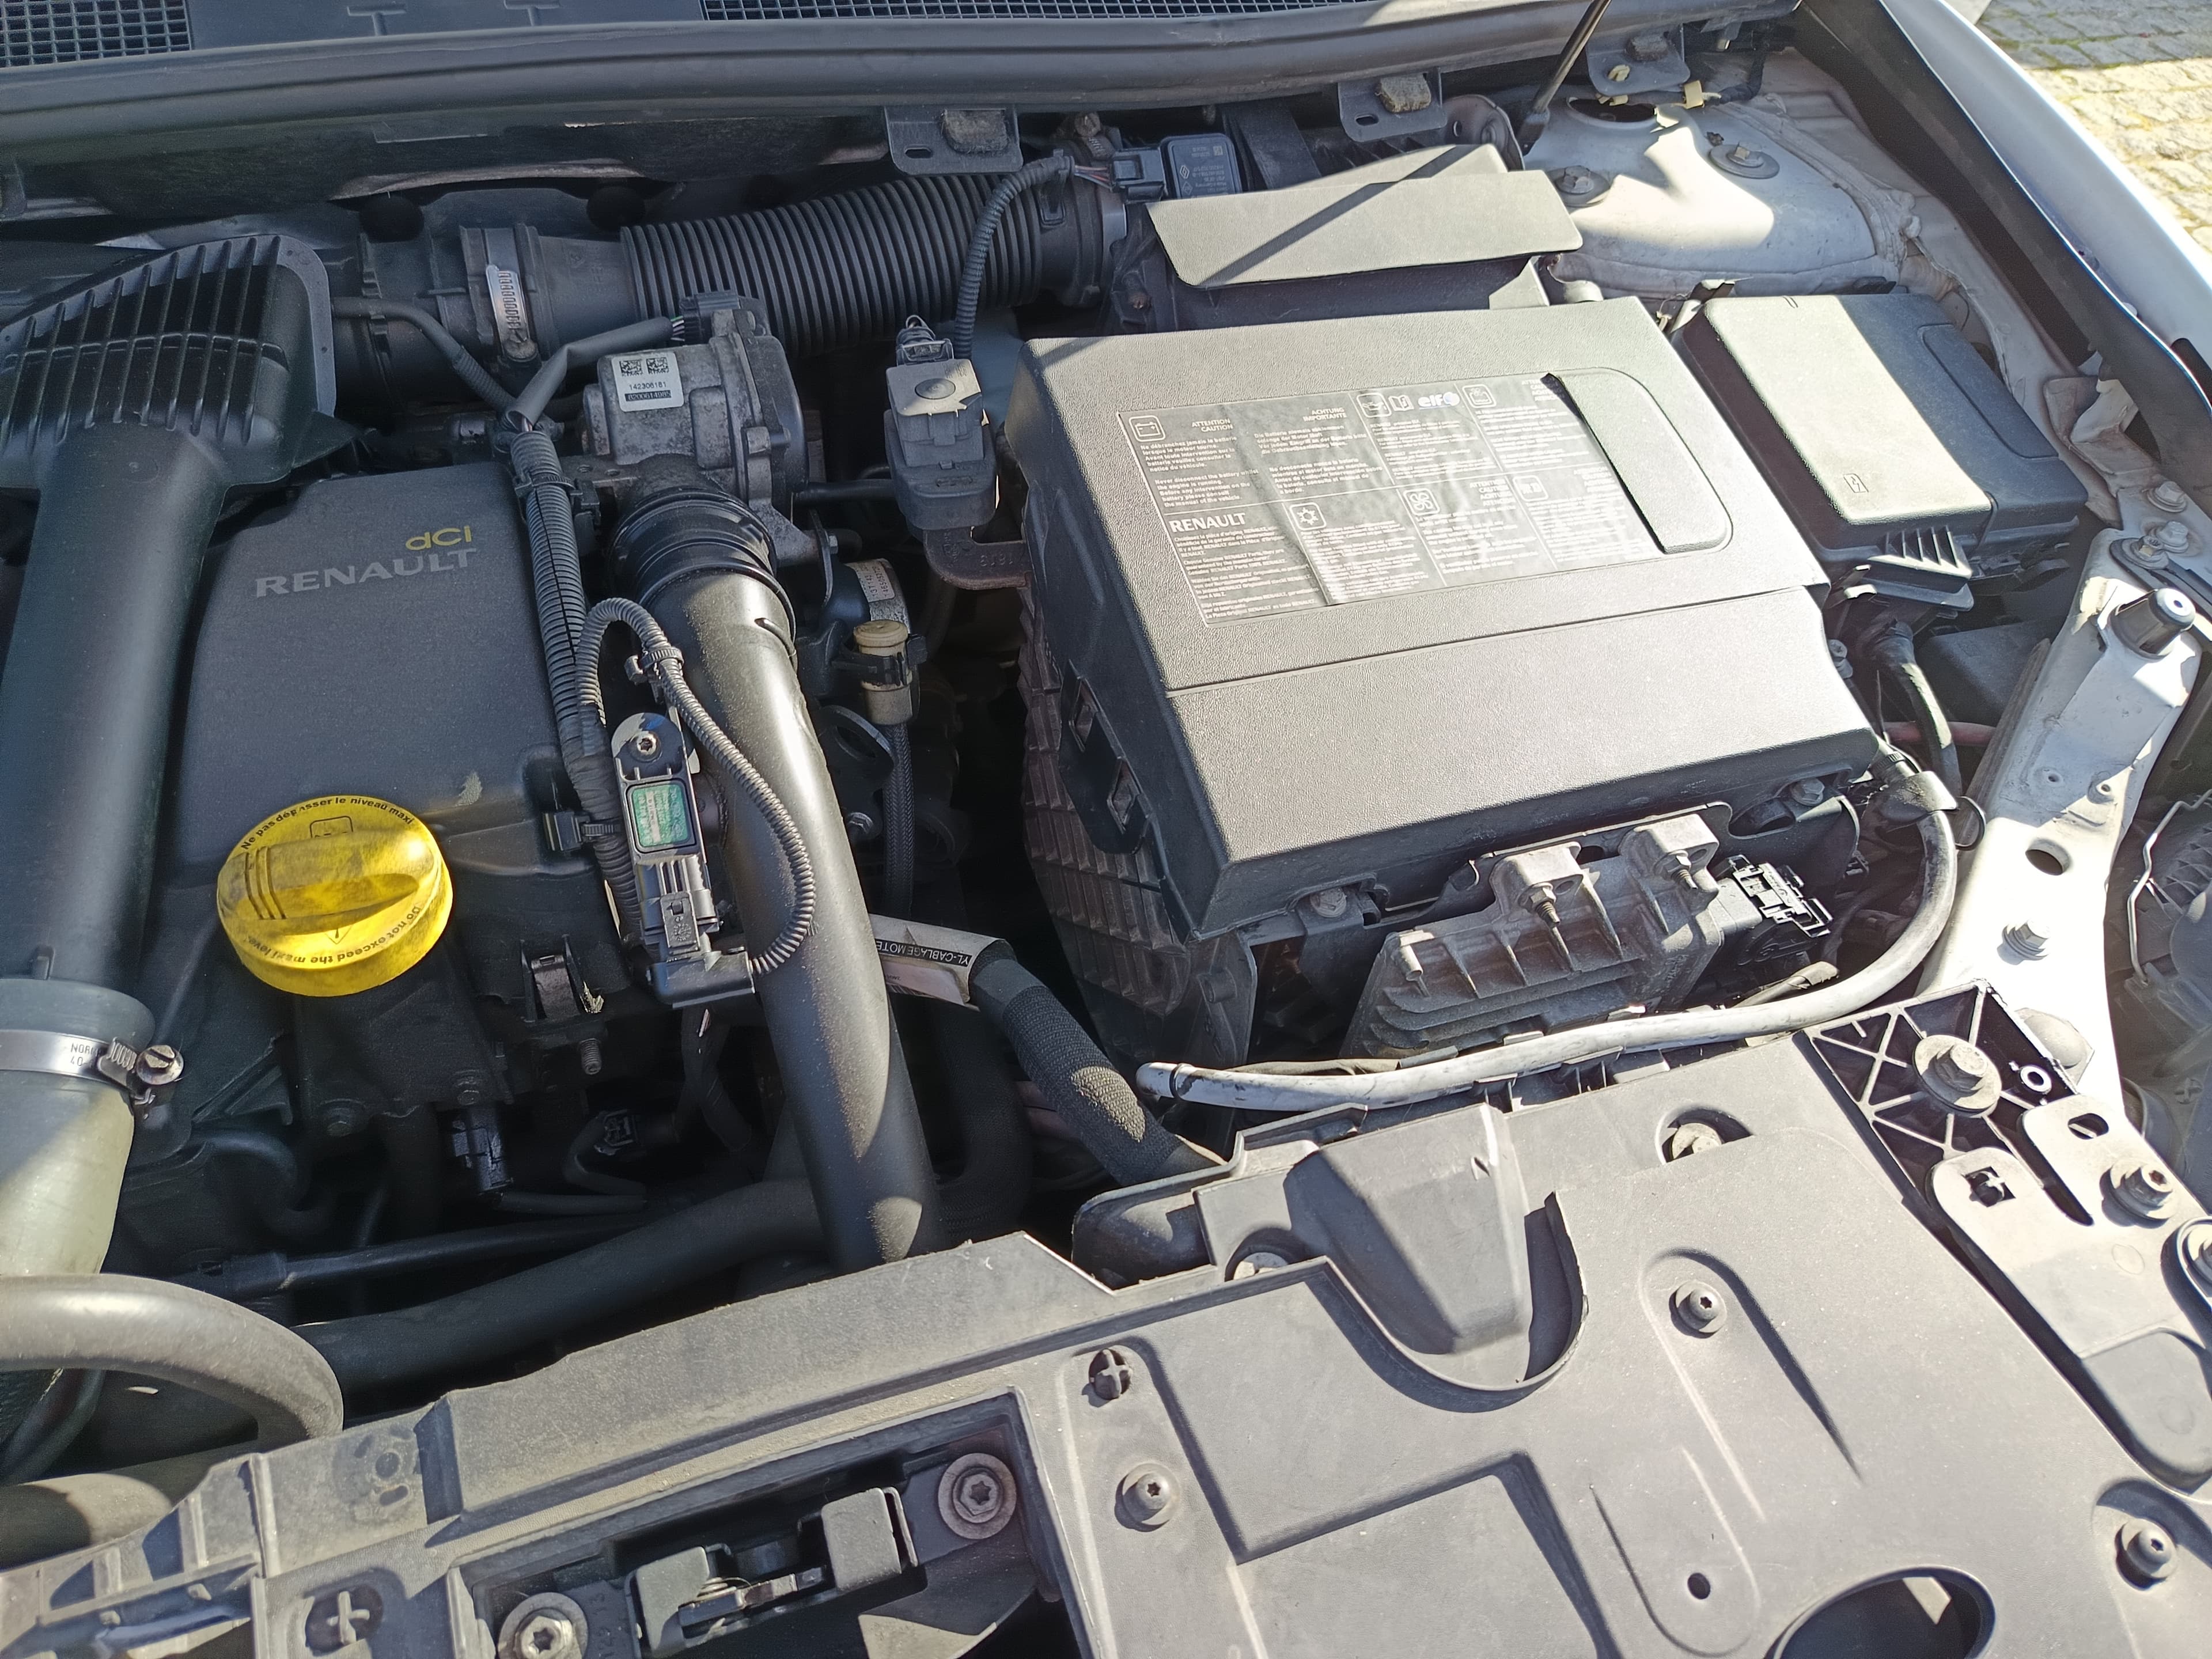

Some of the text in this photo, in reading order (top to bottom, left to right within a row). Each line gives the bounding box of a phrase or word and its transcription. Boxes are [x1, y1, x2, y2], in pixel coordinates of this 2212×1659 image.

[1418, 394, 1443, 407] elf
[1302, 412, 1347, 422] IMPORTANTE
[1310, 407, 1344, 415] ACHTUNG
[1190, 418, 1231, 427] ATTENTION
[1200, 423, 1233, 433] CAUTION
[1168, 482, 1190, 490] engine
[1197, 478, 1223, 486] running.
[1173, 474, 1207, 483] disconnect
[1169, 513, 1245, 532] RENAULT
[255, 548, 476, 598] RENAULT
[241, 836, 255, 850] Ne
[256, 821, 275, 836] pas
[350, 797, 388, 810] niveau
[389, 808, 416, 825] maxi
[407, 906, 421, 920] Do
[387, 921, 407, 938] not
[338, 935, 387, 962] exceed
[271, 951, 306, 963] maxi
[310, 955, 333, 964] the
[907, 946, 968, 965] YL-CABLAGE
